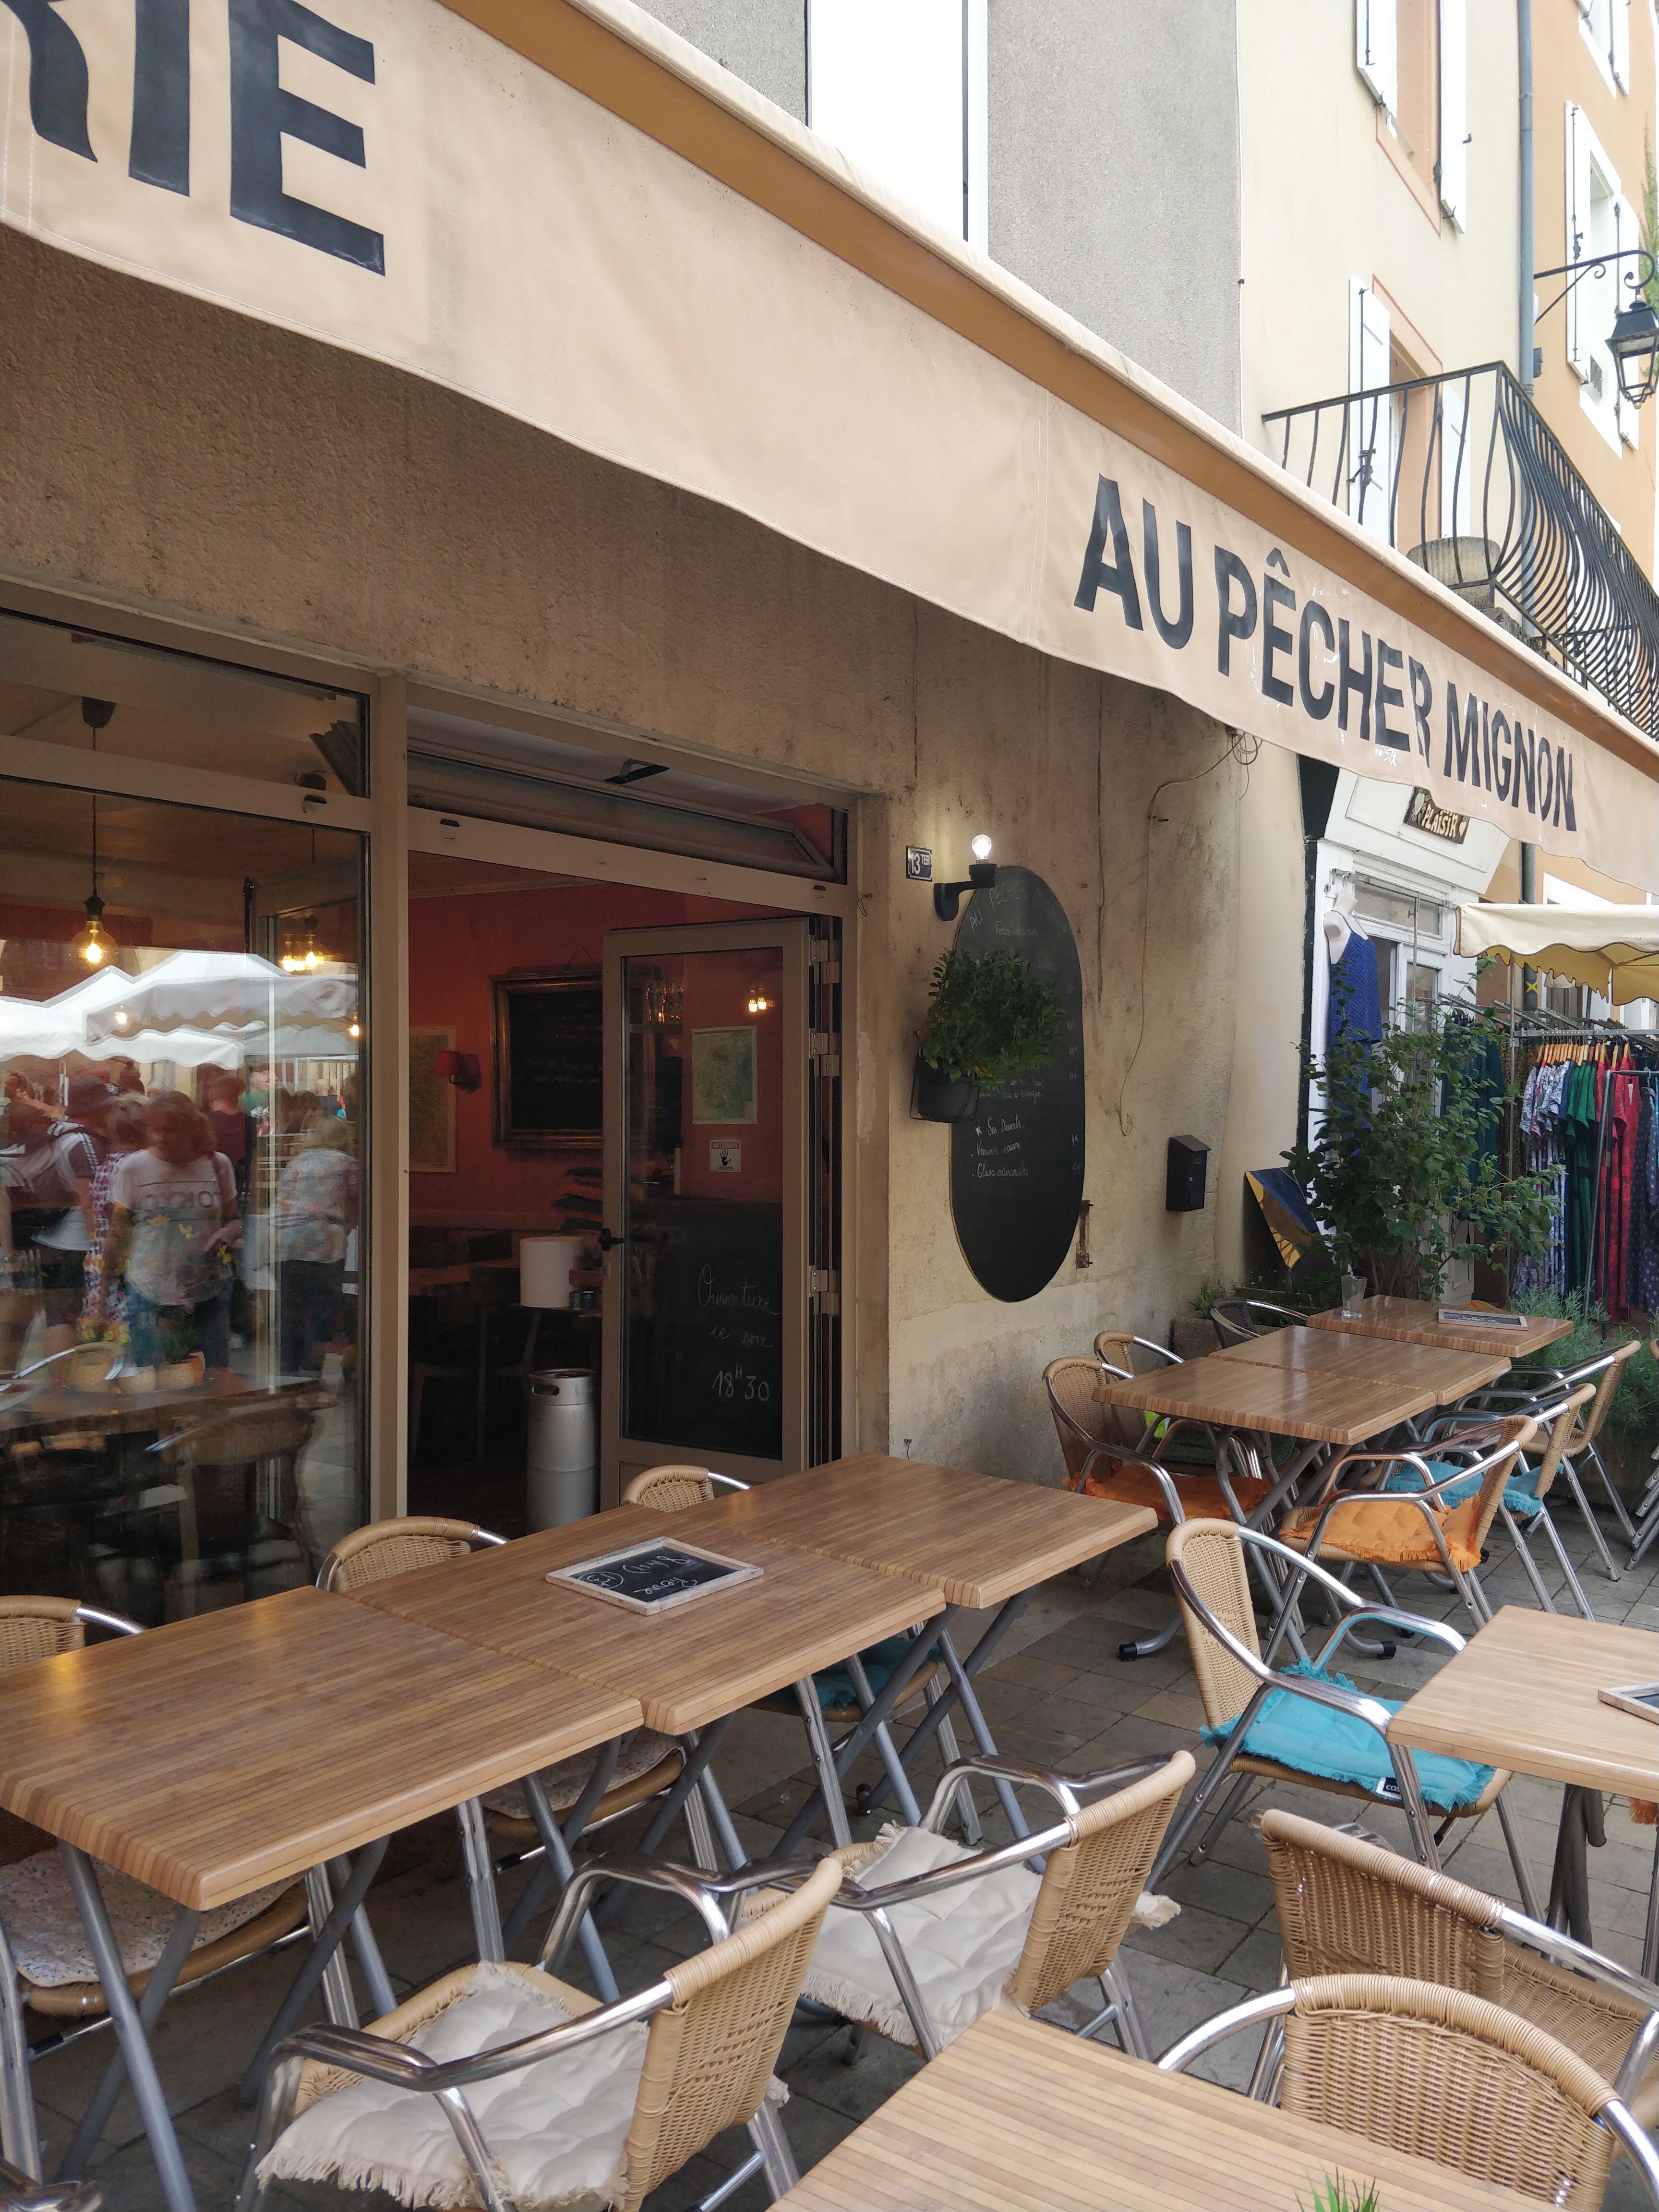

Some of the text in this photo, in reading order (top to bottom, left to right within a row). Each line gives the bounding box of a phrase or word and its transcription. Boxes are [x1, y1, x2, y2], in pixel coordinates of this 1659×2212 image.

[1073, 473, 1576, 832] AU PÊCHER MIGNON
